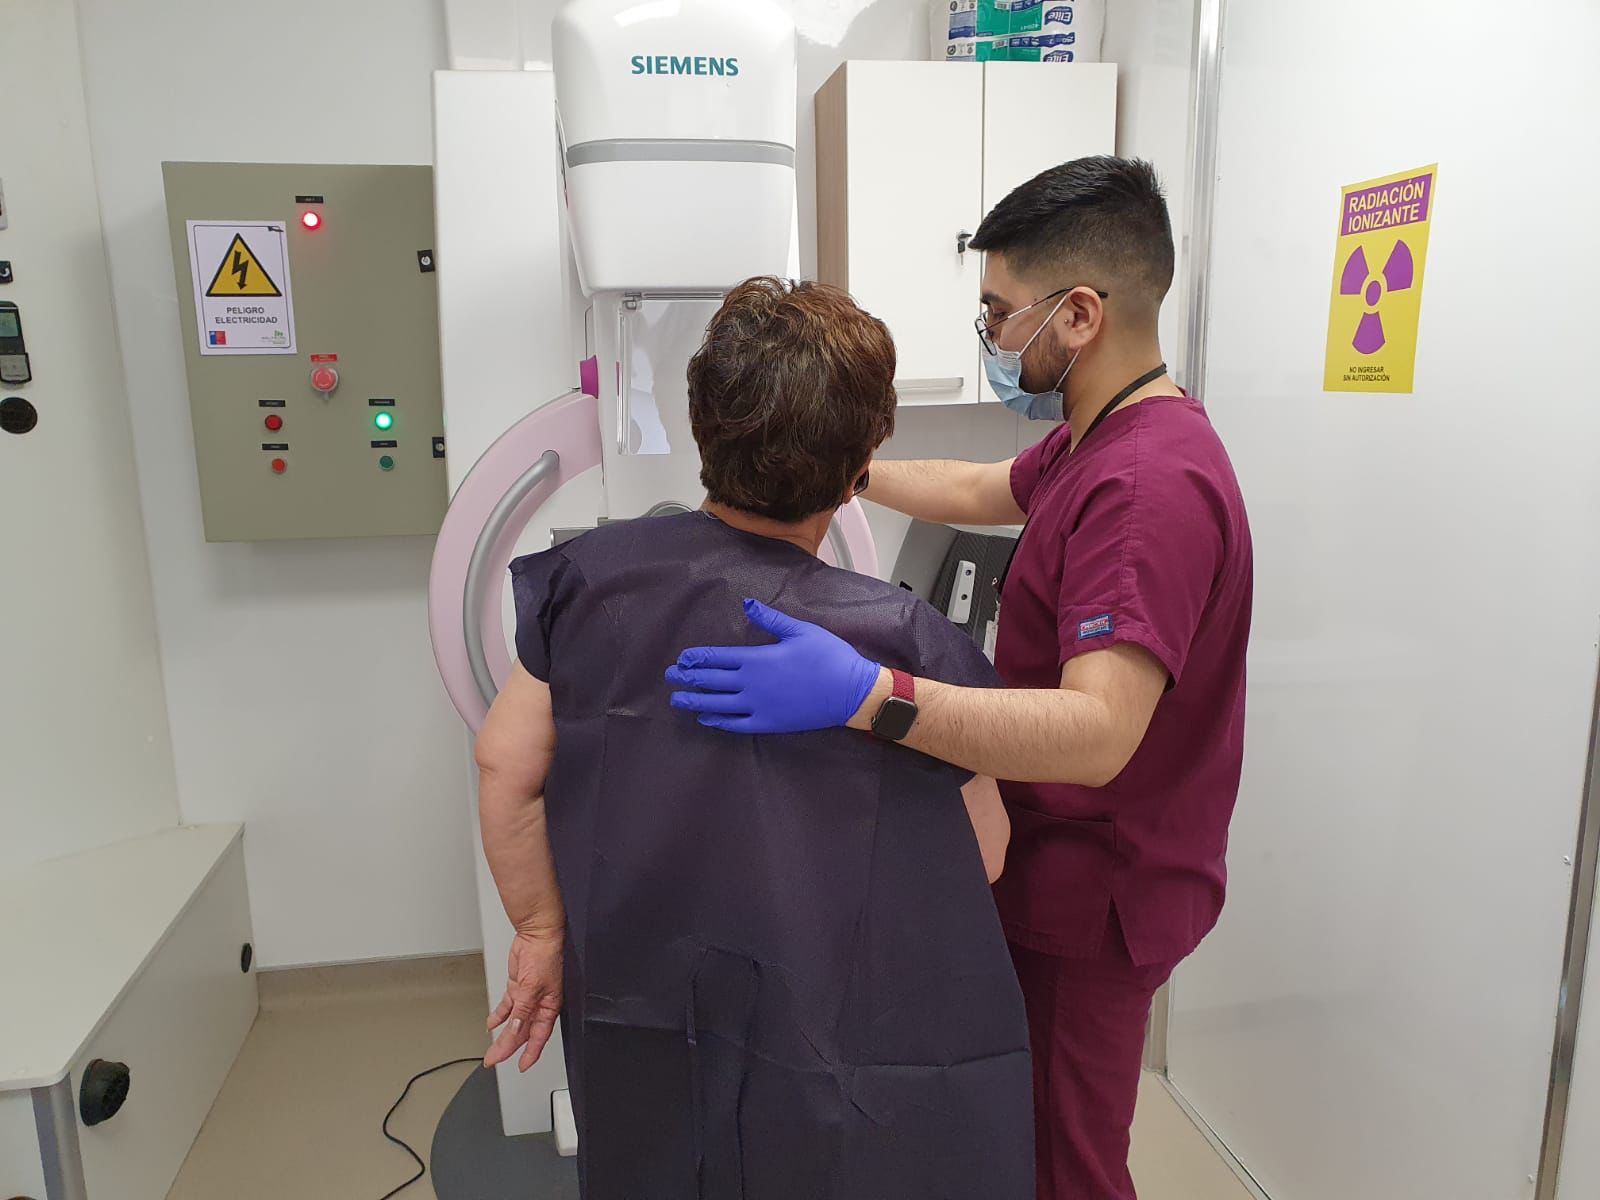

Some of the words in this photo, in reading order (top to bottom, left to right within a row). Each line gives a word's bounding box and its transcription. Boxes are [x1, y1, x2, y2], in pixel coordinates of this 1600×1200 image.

[1047, 11, 1071, 22] Elite
[631, 55, 739, 76] SIEMENS
[1348, 179, 1425, 213] RADIACIÓN
[1348, 203, 1420, 233] IONIZANTE
[226, 306, 265, 315] PELIGRO
[215, 316, 278, 324] ELECTRICIDAD
[1352, 372, 1390, 381] AUTORIZACIÓN
